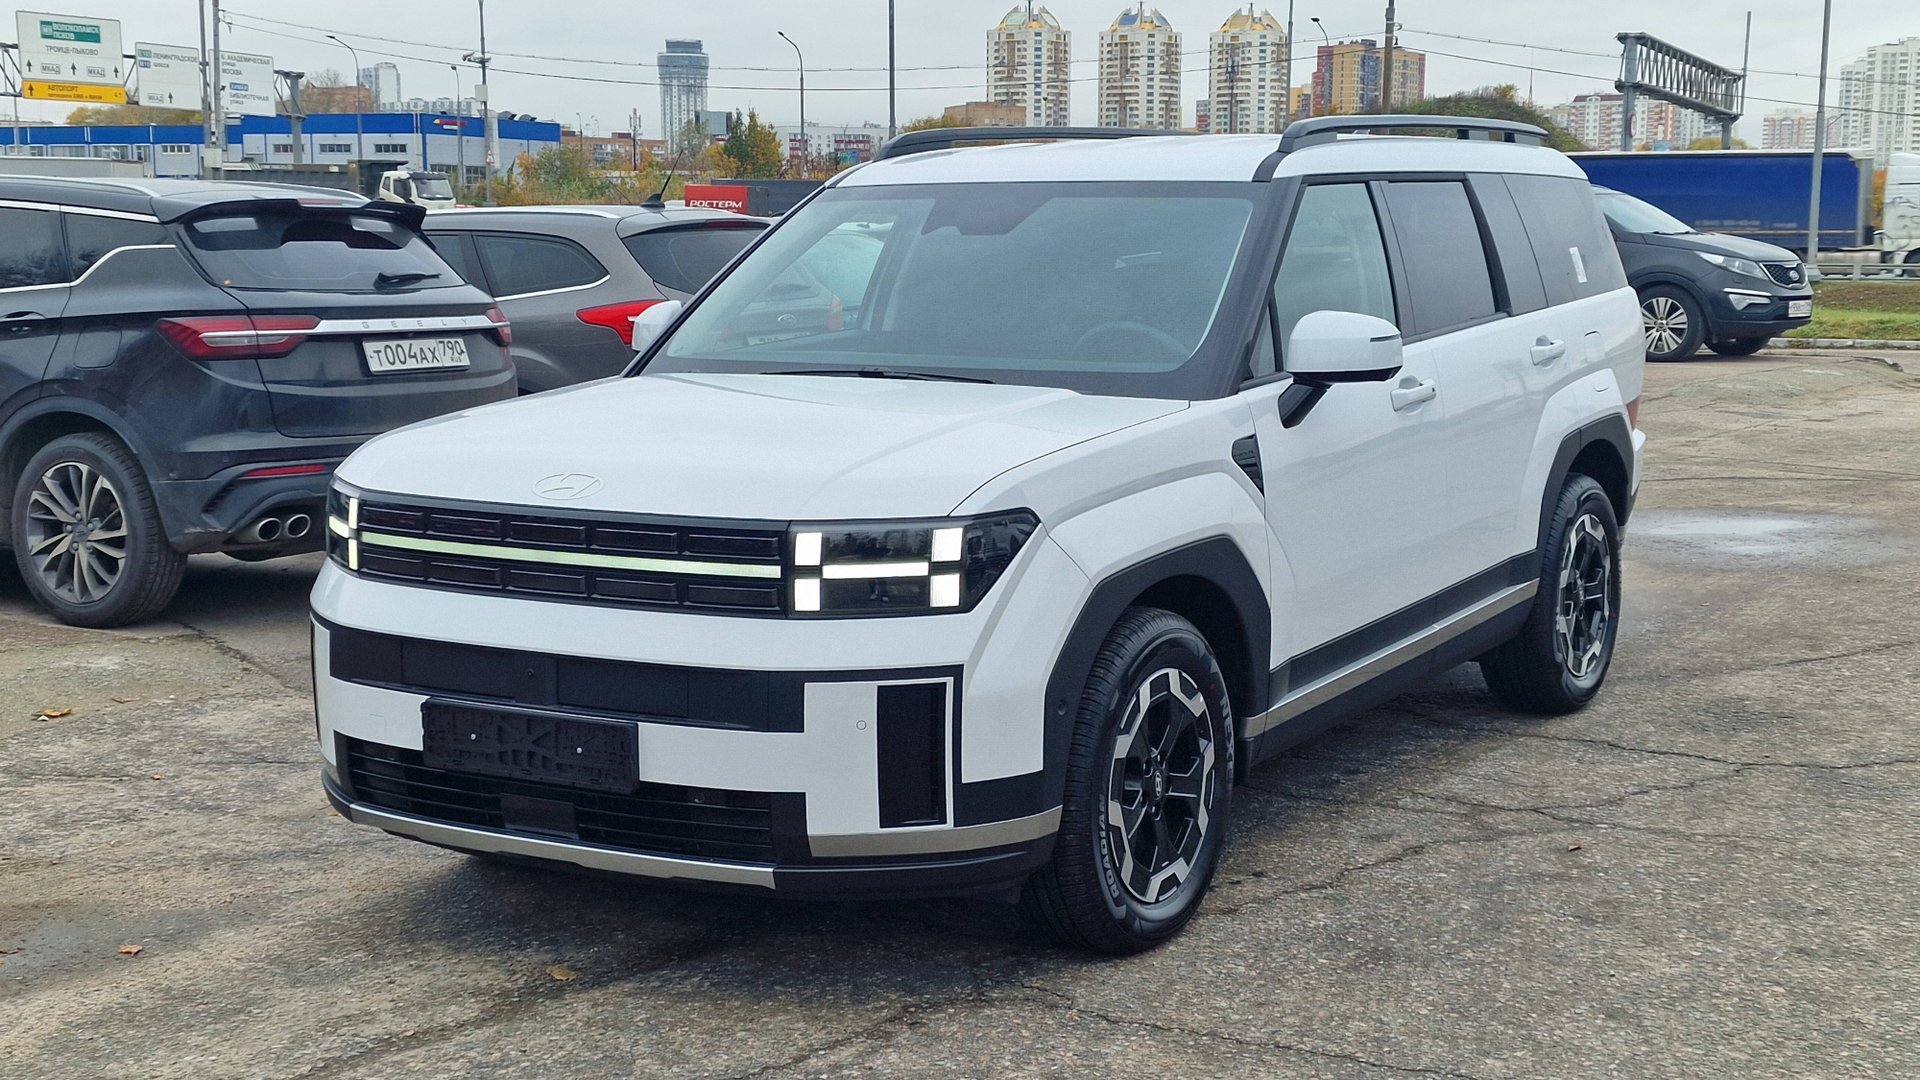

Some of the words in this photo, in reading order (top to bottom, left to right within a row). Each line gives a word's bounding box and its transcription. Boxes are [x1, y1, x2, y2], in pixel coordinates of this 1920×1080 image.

[45, 45, 99, 56] ТРОИЦЕ-ЛЫКОВО
[42, 65, 60, 73] МКАД
[88, 68, 105, 76] МКАД
[148, 95, 164, 103] МКАД
[690, 200, 743, 208] РОСТЕРМ
[361, 318, 468, 329] GEELY
